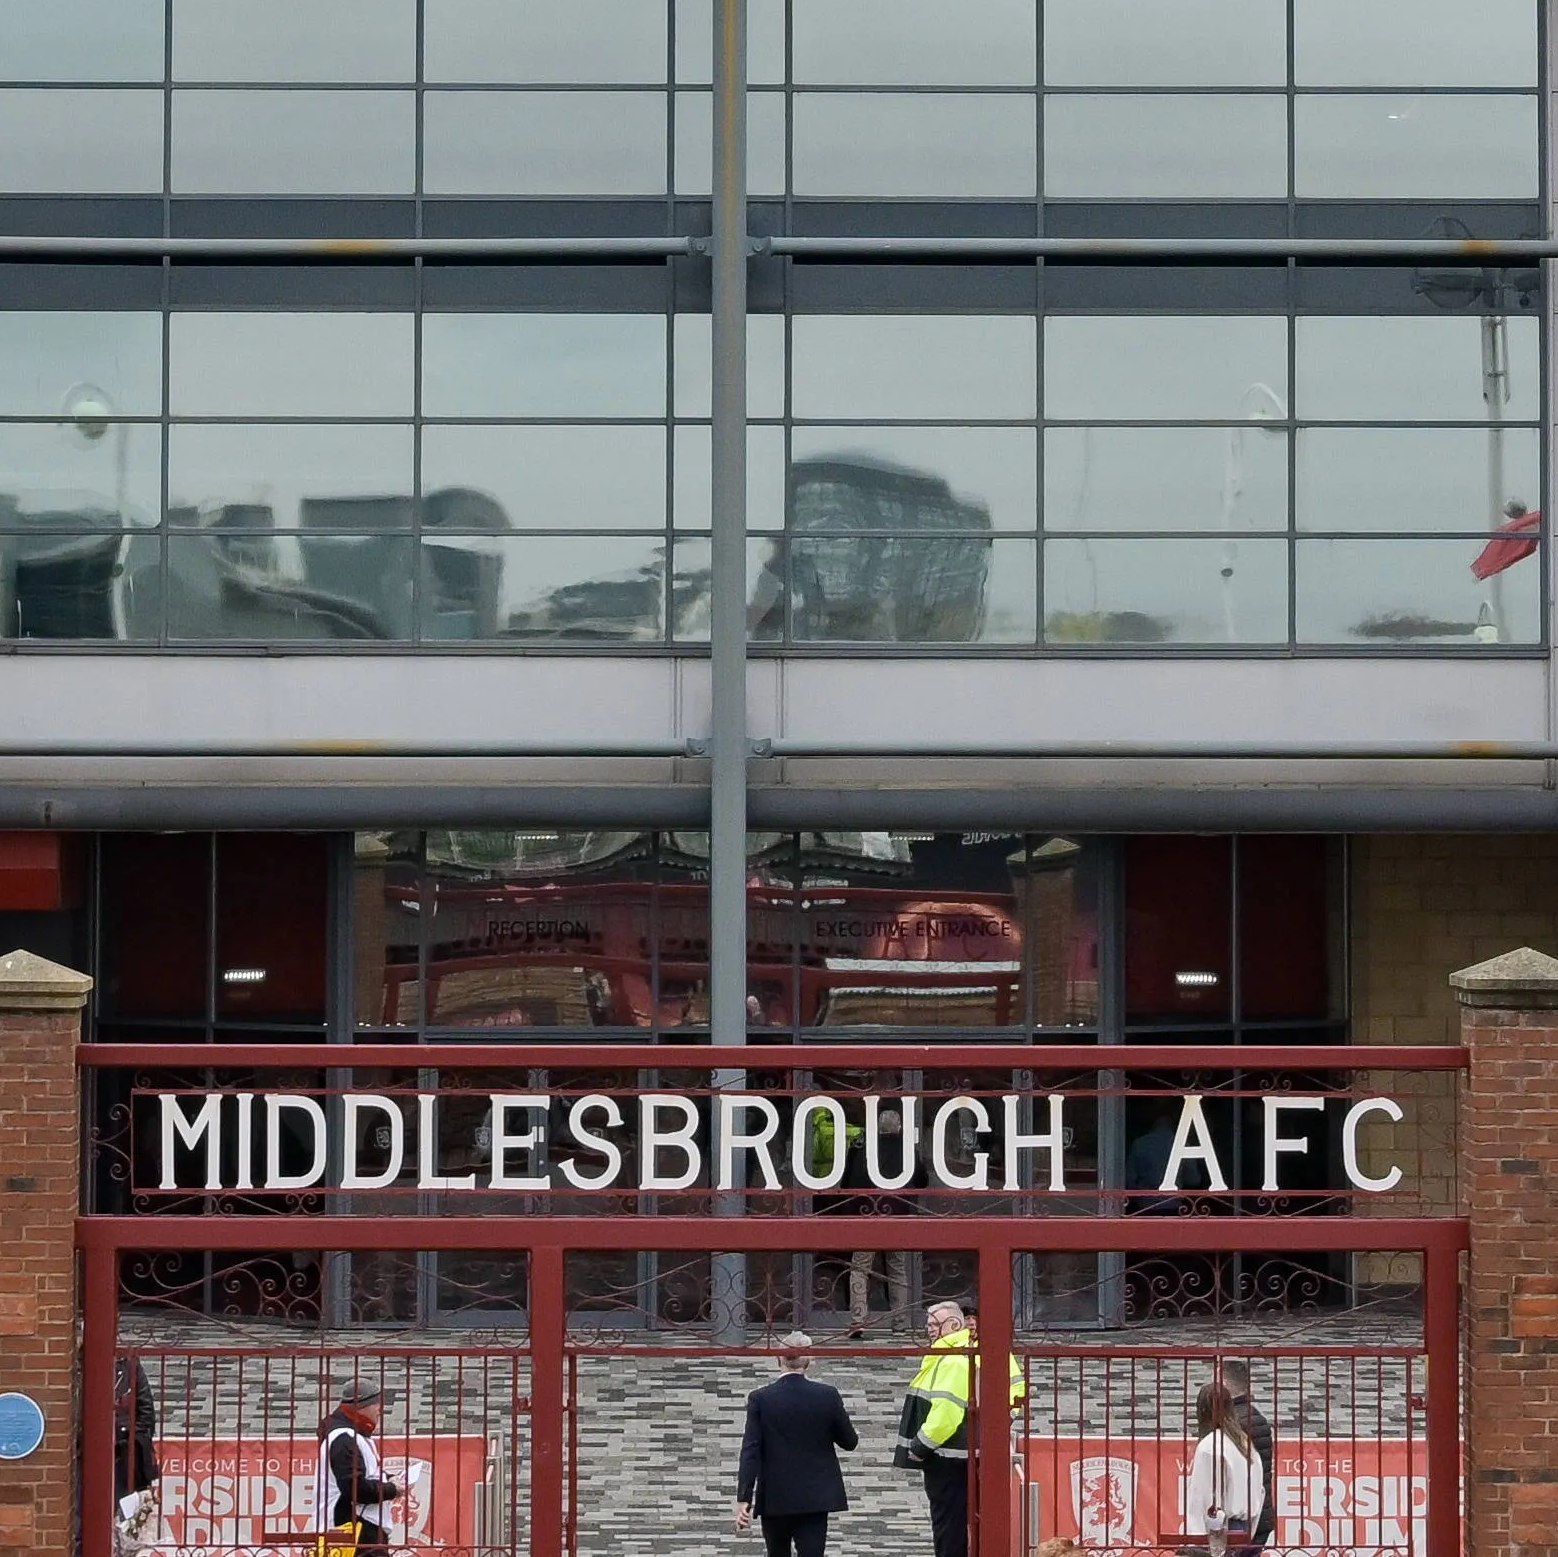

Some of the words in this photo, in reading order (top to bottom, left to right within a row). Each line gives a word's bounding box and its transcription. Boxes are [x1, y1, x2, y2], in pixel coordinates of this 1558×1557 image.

[488, 920, 590, 938] RECEPTION
[816, 920, 909, 938] EXECUTIVE
[915, 920, 1012, 938] ENTRANCE
[158, 1093, 1068, 1191] MIDDLESBROUGH
[1159, 1094, 1404, 1192] AFC
[256, 1458, 281, 1473] TO
[1282, 1458, 1308, 1474] TO
[161, 1475, 316, 1516] RSIDE
